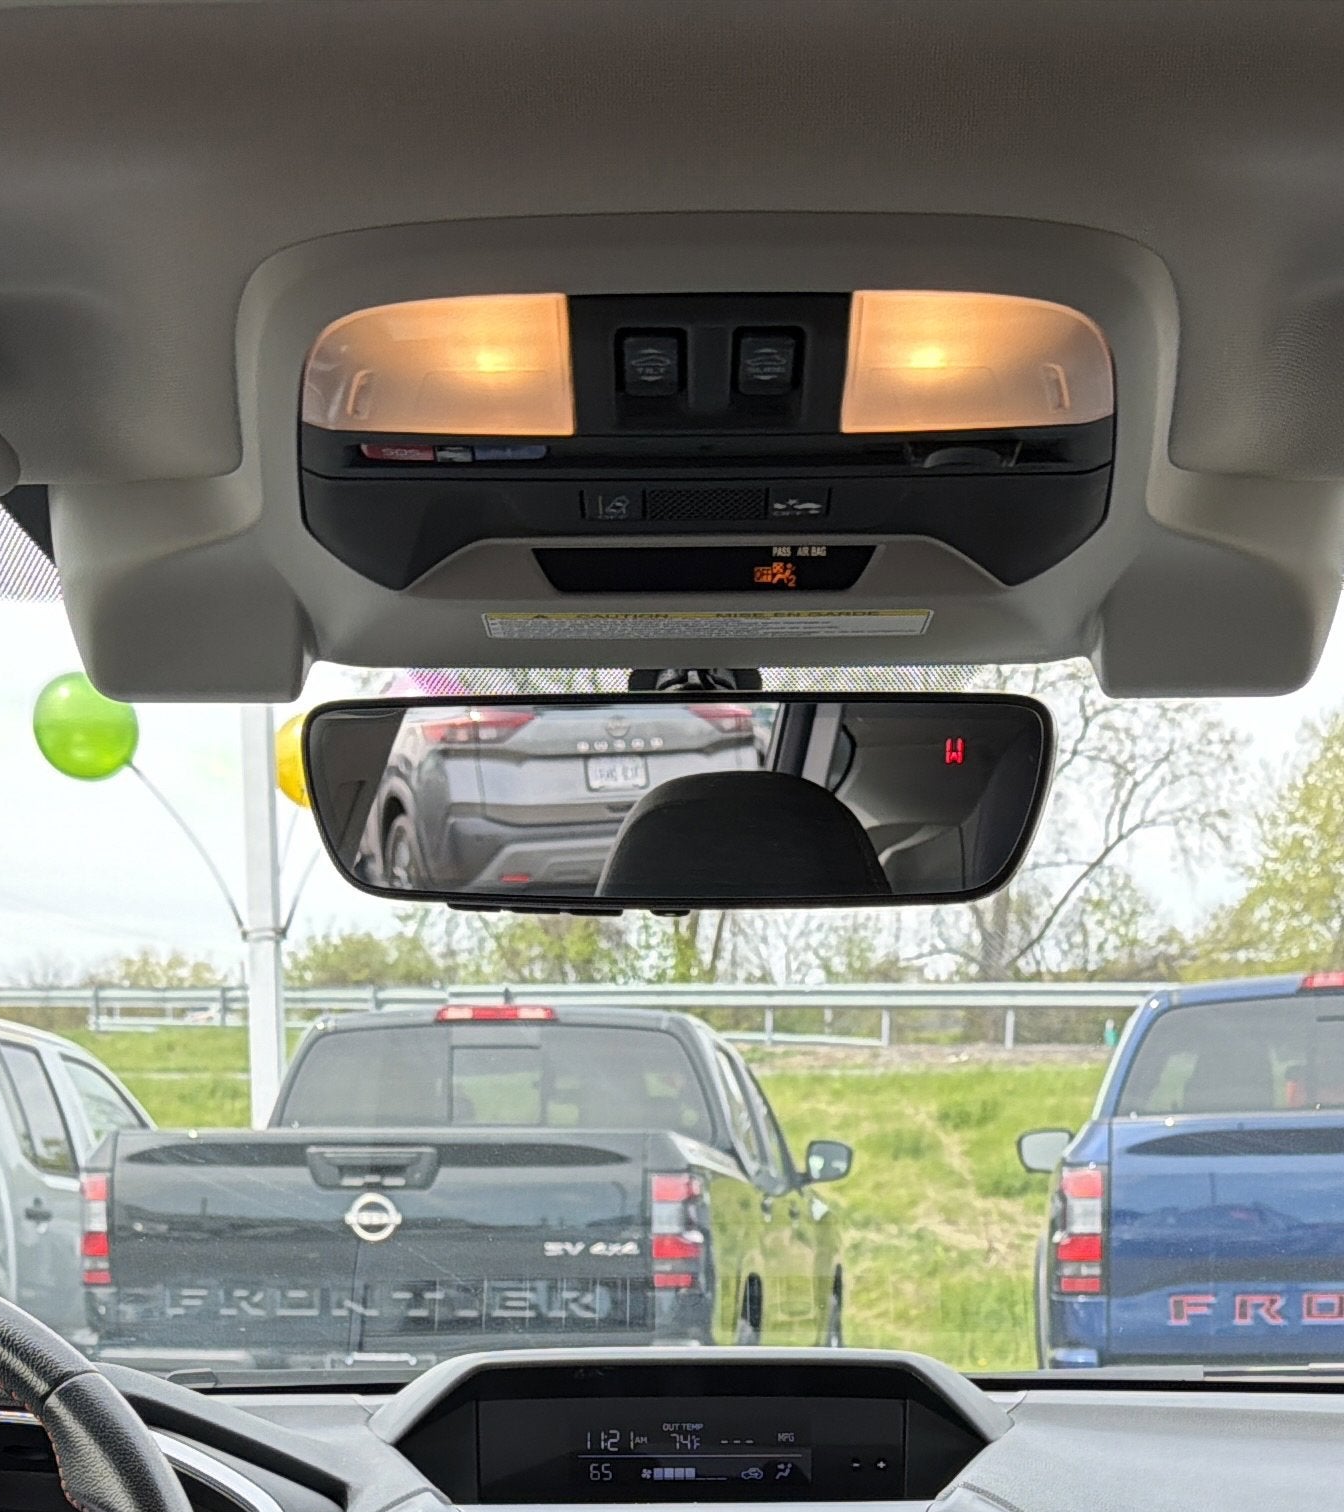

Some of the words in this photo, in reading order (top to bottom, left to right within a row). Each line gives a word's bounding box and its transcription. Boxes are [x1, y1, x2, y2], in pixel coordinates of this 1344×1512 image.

[772, 546, 792, 557] PASS
[797, 546, 810, 557] AIR
[811, 546, 827, 557] BAG
[543, 1241, 586, 1257] SV
[164, 1284, 612, 1319] FRONTIER
[662, 1422, 680, 1431] OUT
[681, 1422, 704, 1431] TEMP
[587, 1430, 635, 1451] 11:21
[635, 1436, 648, 1444] AM
[777, 1432, 795, 1442] MPG
[589, 1463, 613, 1481] 65
